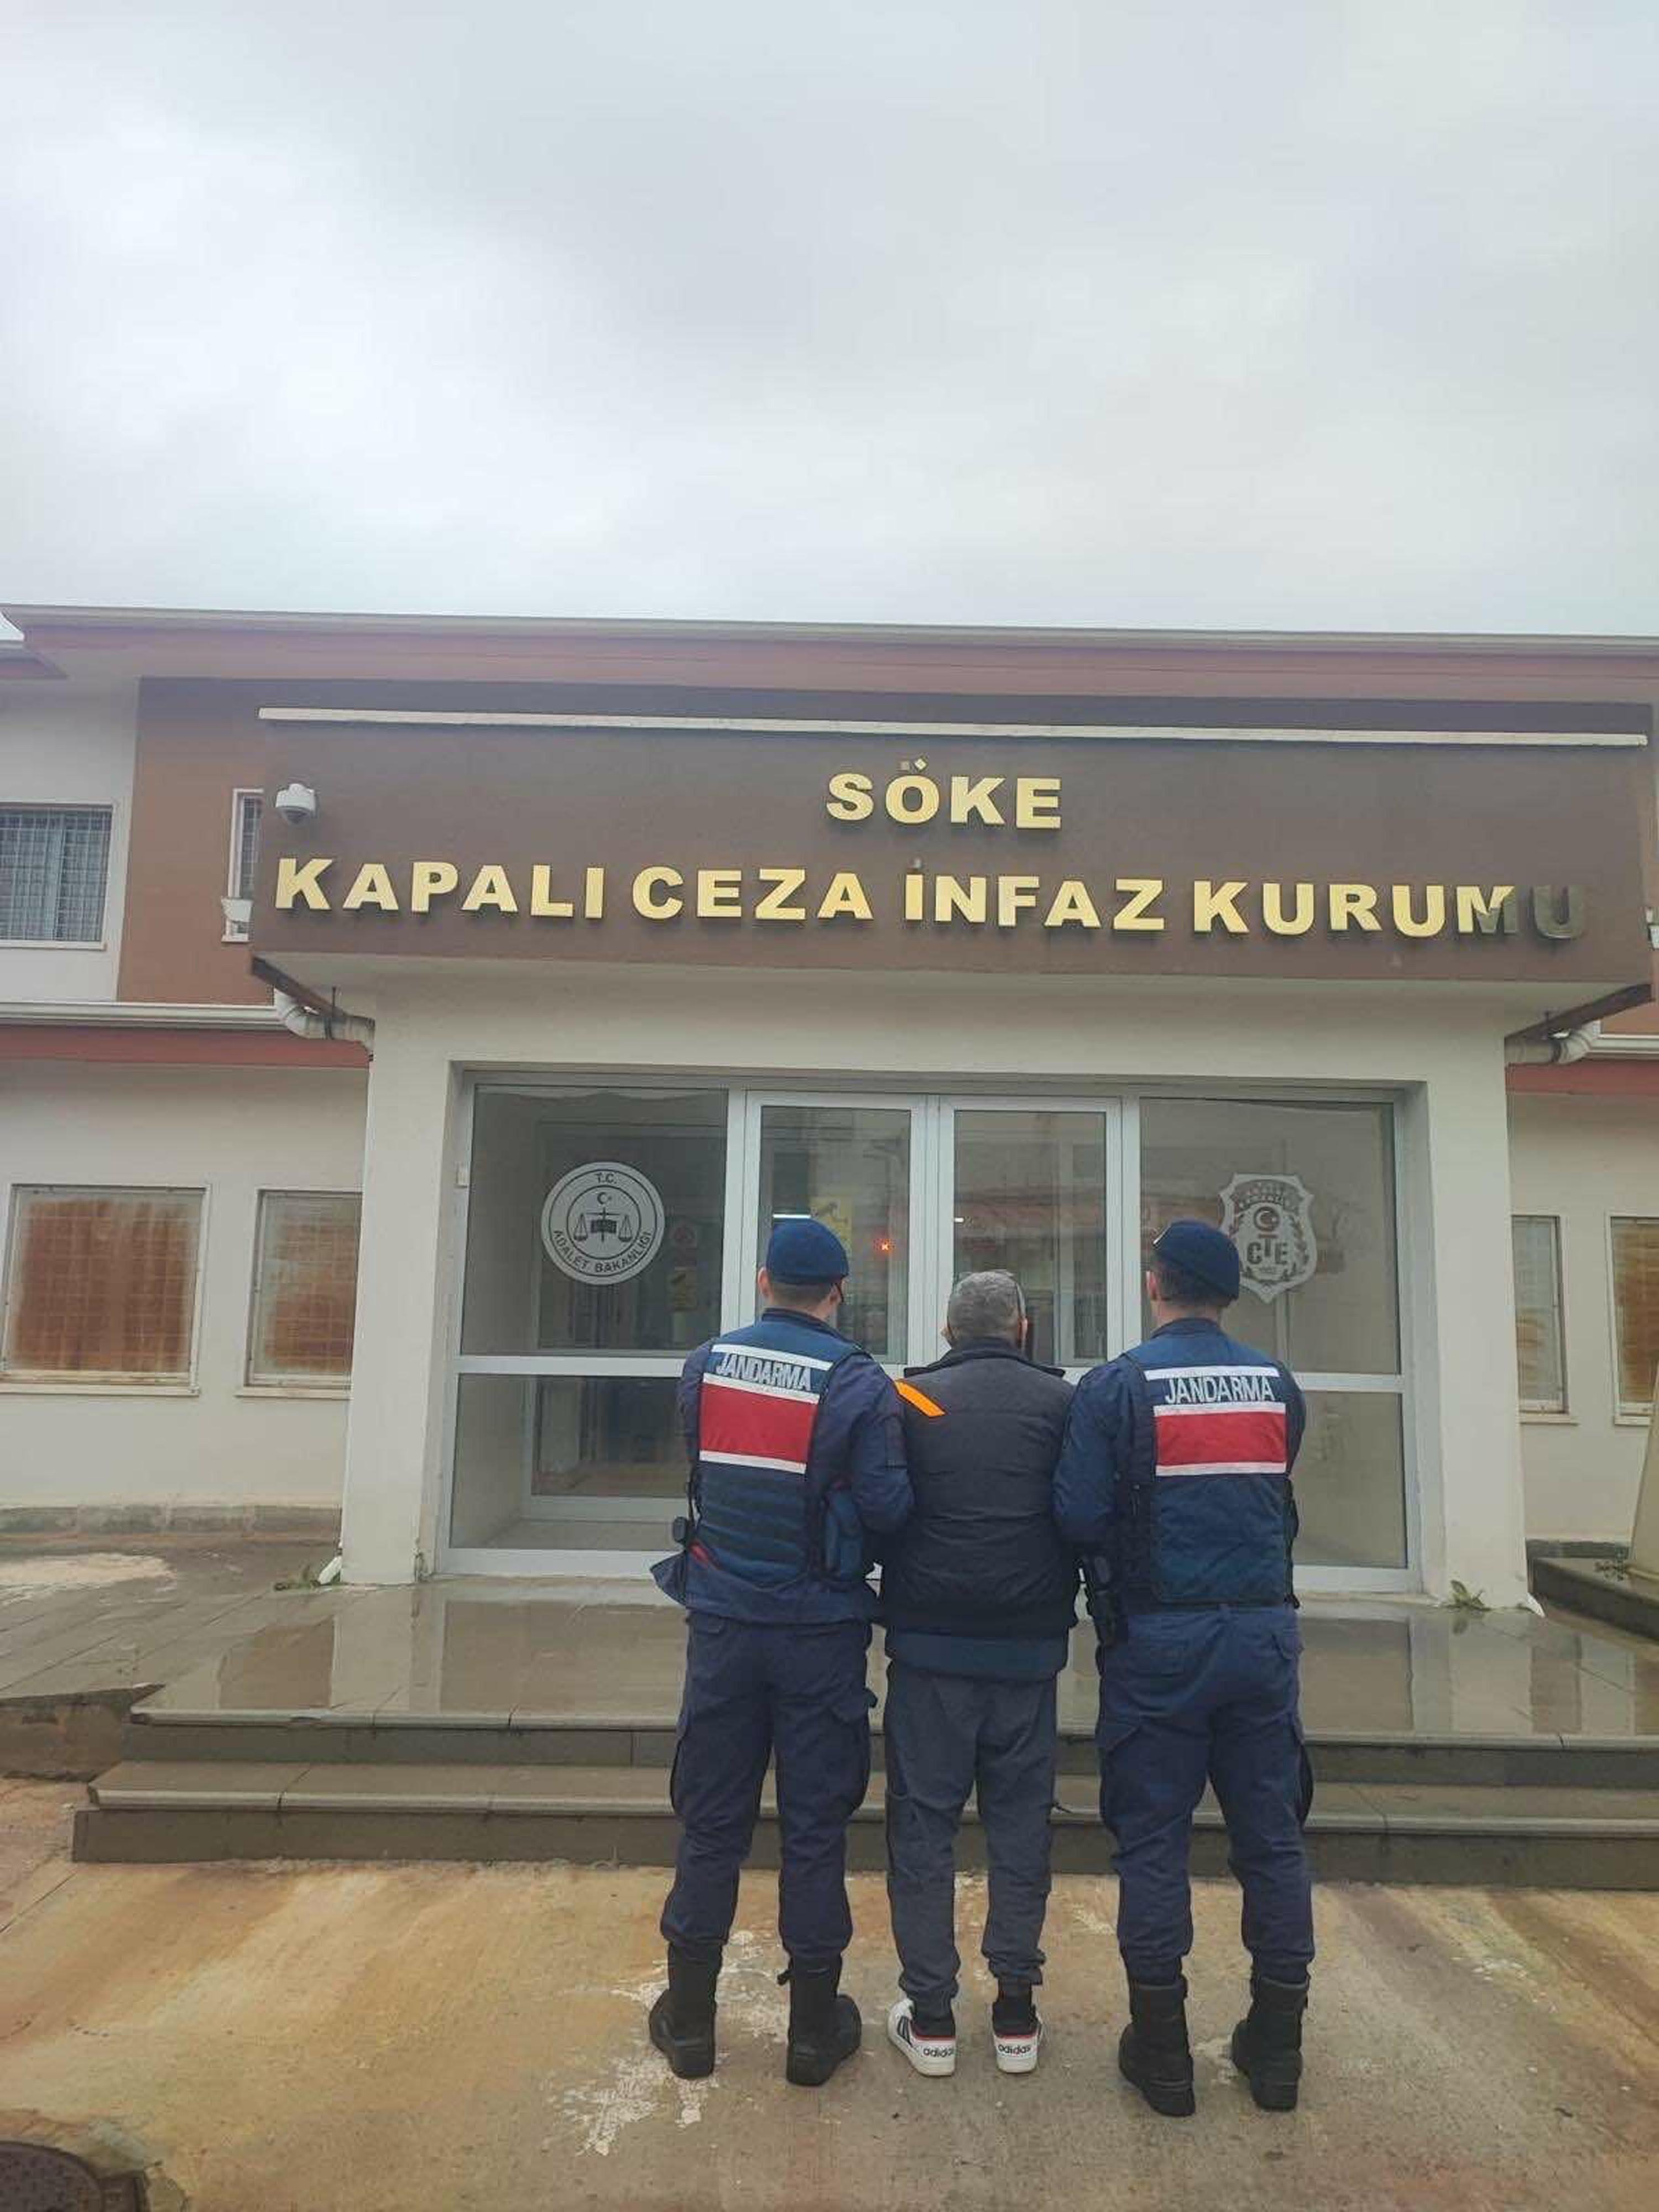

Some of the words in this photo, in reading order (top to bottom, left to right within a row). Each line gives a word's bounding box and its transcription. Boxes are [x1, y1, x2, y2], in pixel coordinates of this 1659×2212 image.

[826, 757, 1062, 828] SÖKE
[275, 858, 604, 919] KAPALI
[632, 867, 874, 920] CEZA
[905, 858, 1166, 930] İNFAZ
[1193, 880, 1585, 938] KURUMU
[595, 1172, 617, 1184] T.C.
[716, 1353, 811, 1391] JANDARMA
[1165, 1375, 1275, 1404] JANDARMA
[923, 2047, 954, 2058] adida
[998, 2044, 1031, 2056] adidas
